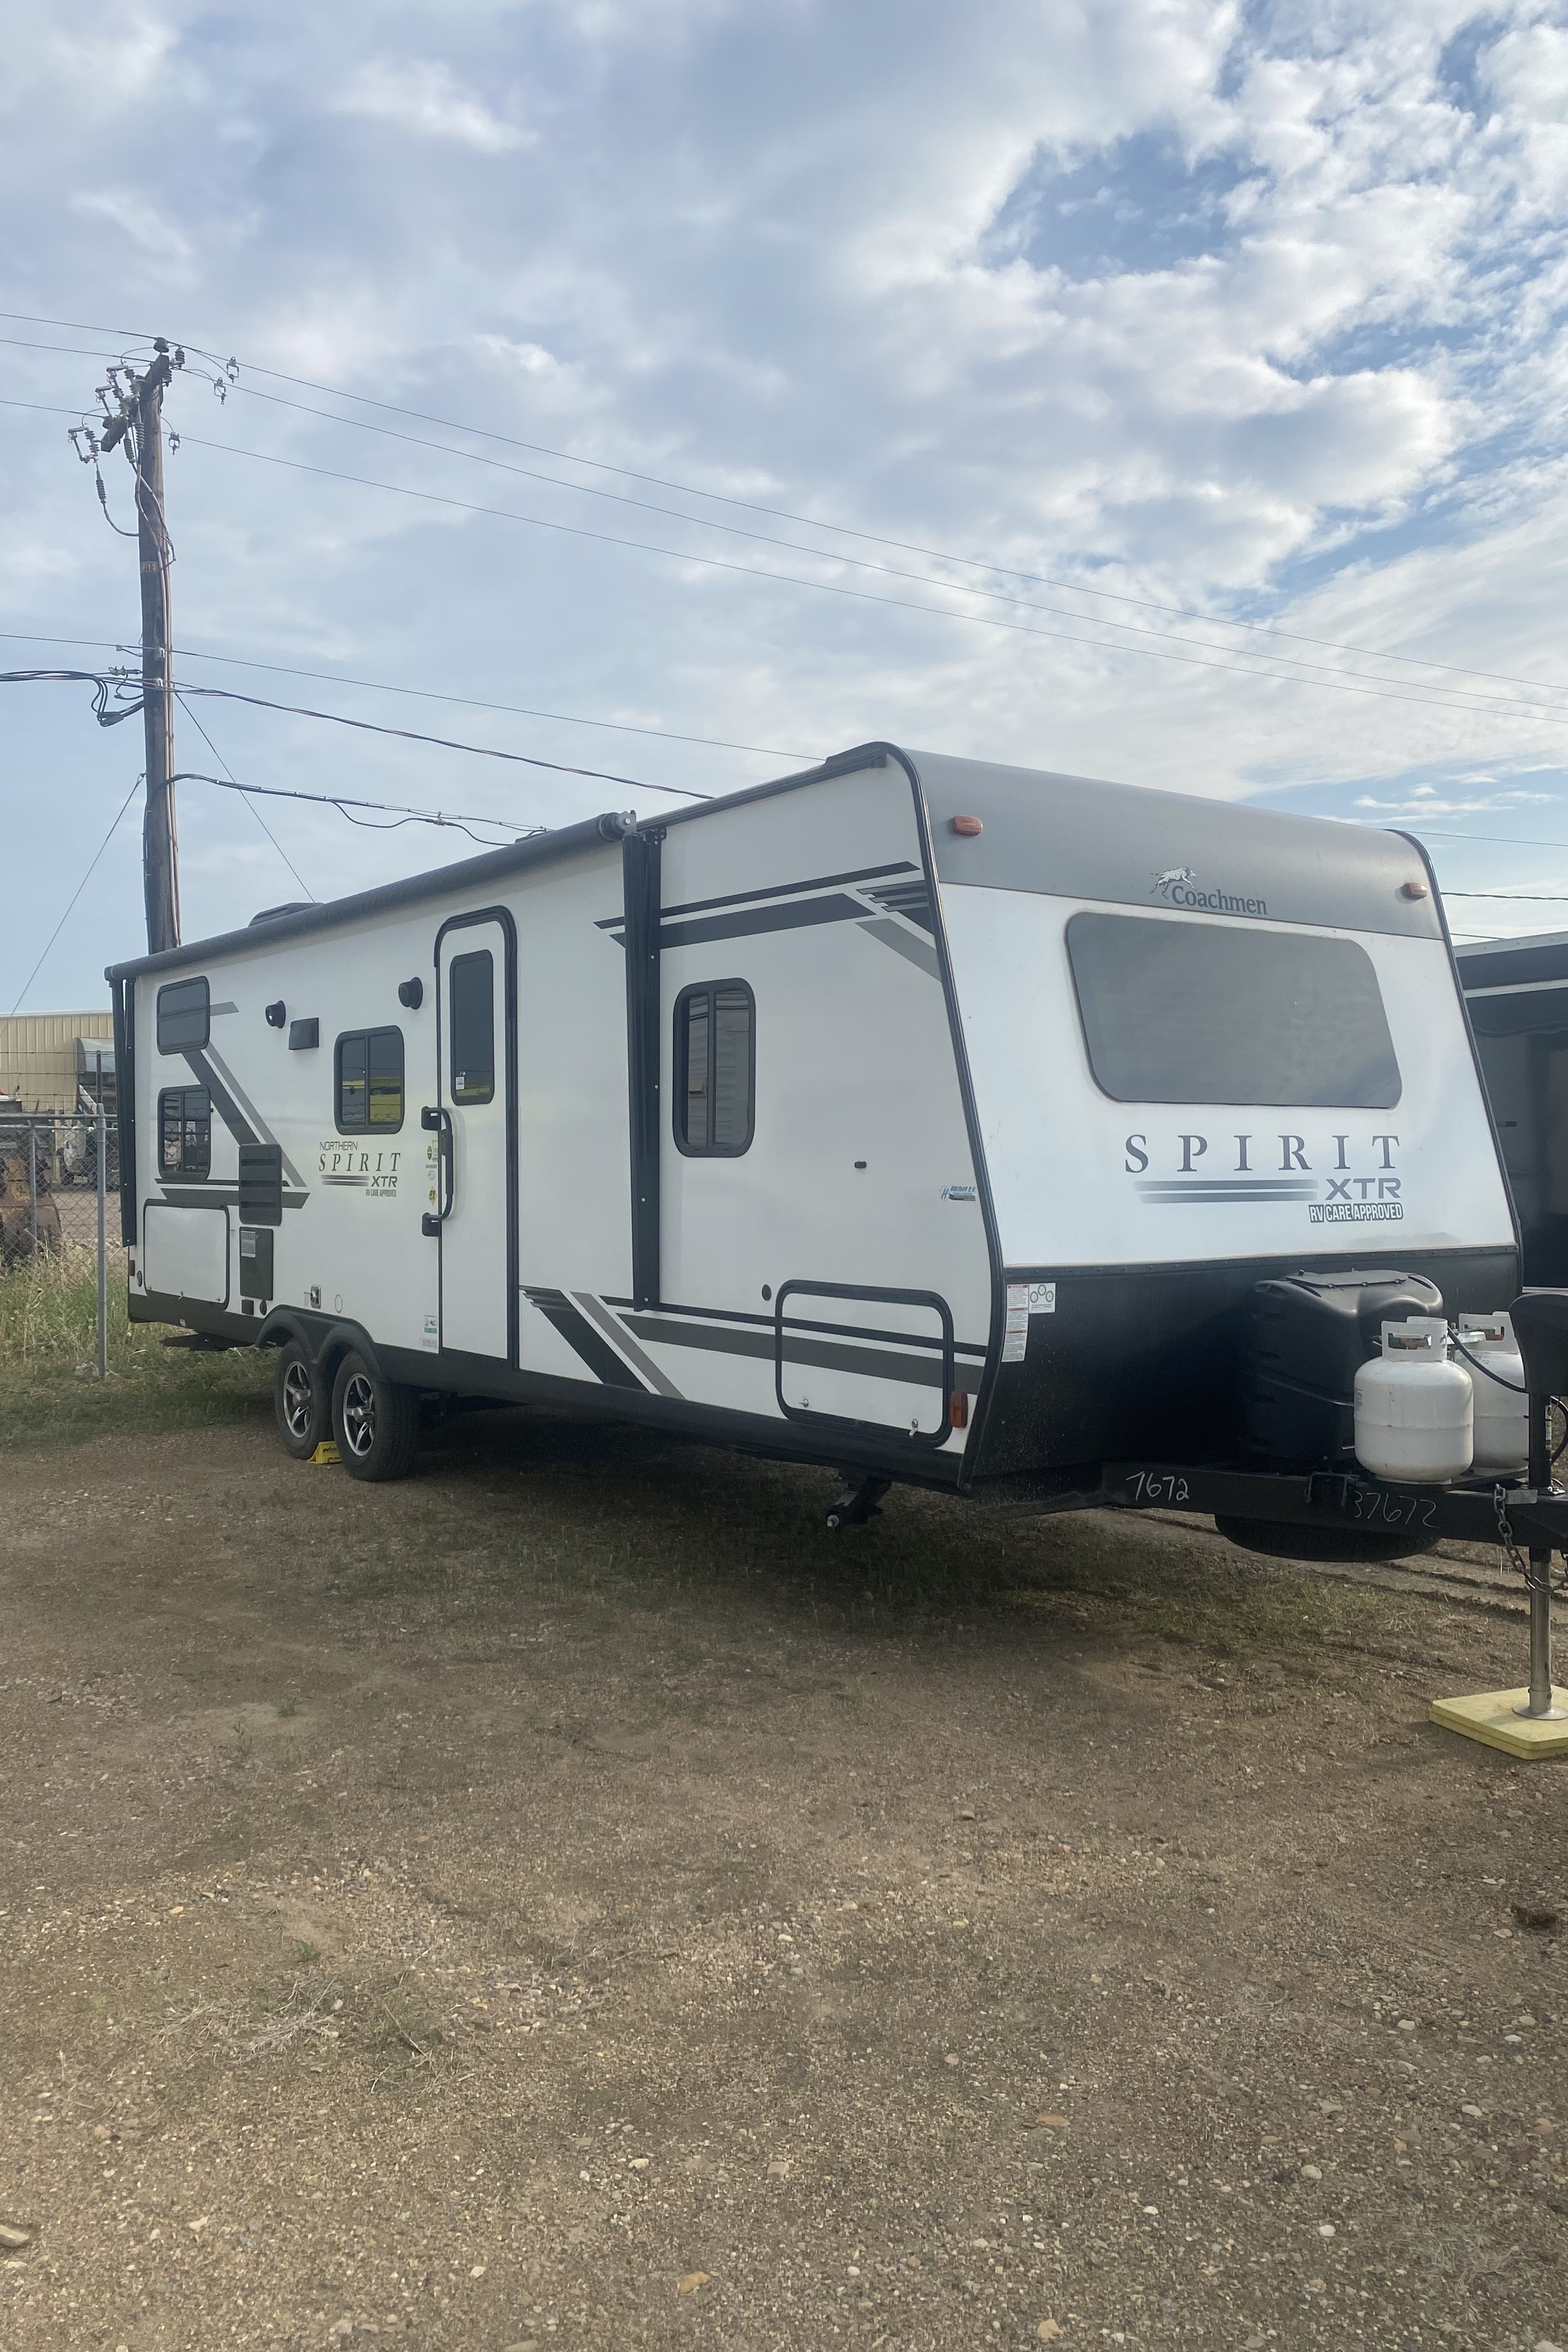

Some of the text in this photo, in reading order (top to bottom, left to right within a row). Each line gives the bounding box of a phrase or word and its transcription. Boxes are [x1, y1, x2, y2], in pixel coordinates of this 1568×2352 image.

[1171, 885, 1268, 915] Coachmen
[319, 1141, 358, 1151] NORTHERN
[1125, 1134, 1400, 1173] SPIRIT
[318, 1152, 401, 1171] SPIRIT
[370, 1175, 398, 1188] XTR
[1325, 1178, 1401, 1200] XTR
[379, 1189, 397, 1198] APPROVED
[1308, 1202, 1404, 1223] RV CARE APPROVED
[1125, 1471, 1190, 1501] 7672
[1354, 1490, 1440, 1528] 37672
